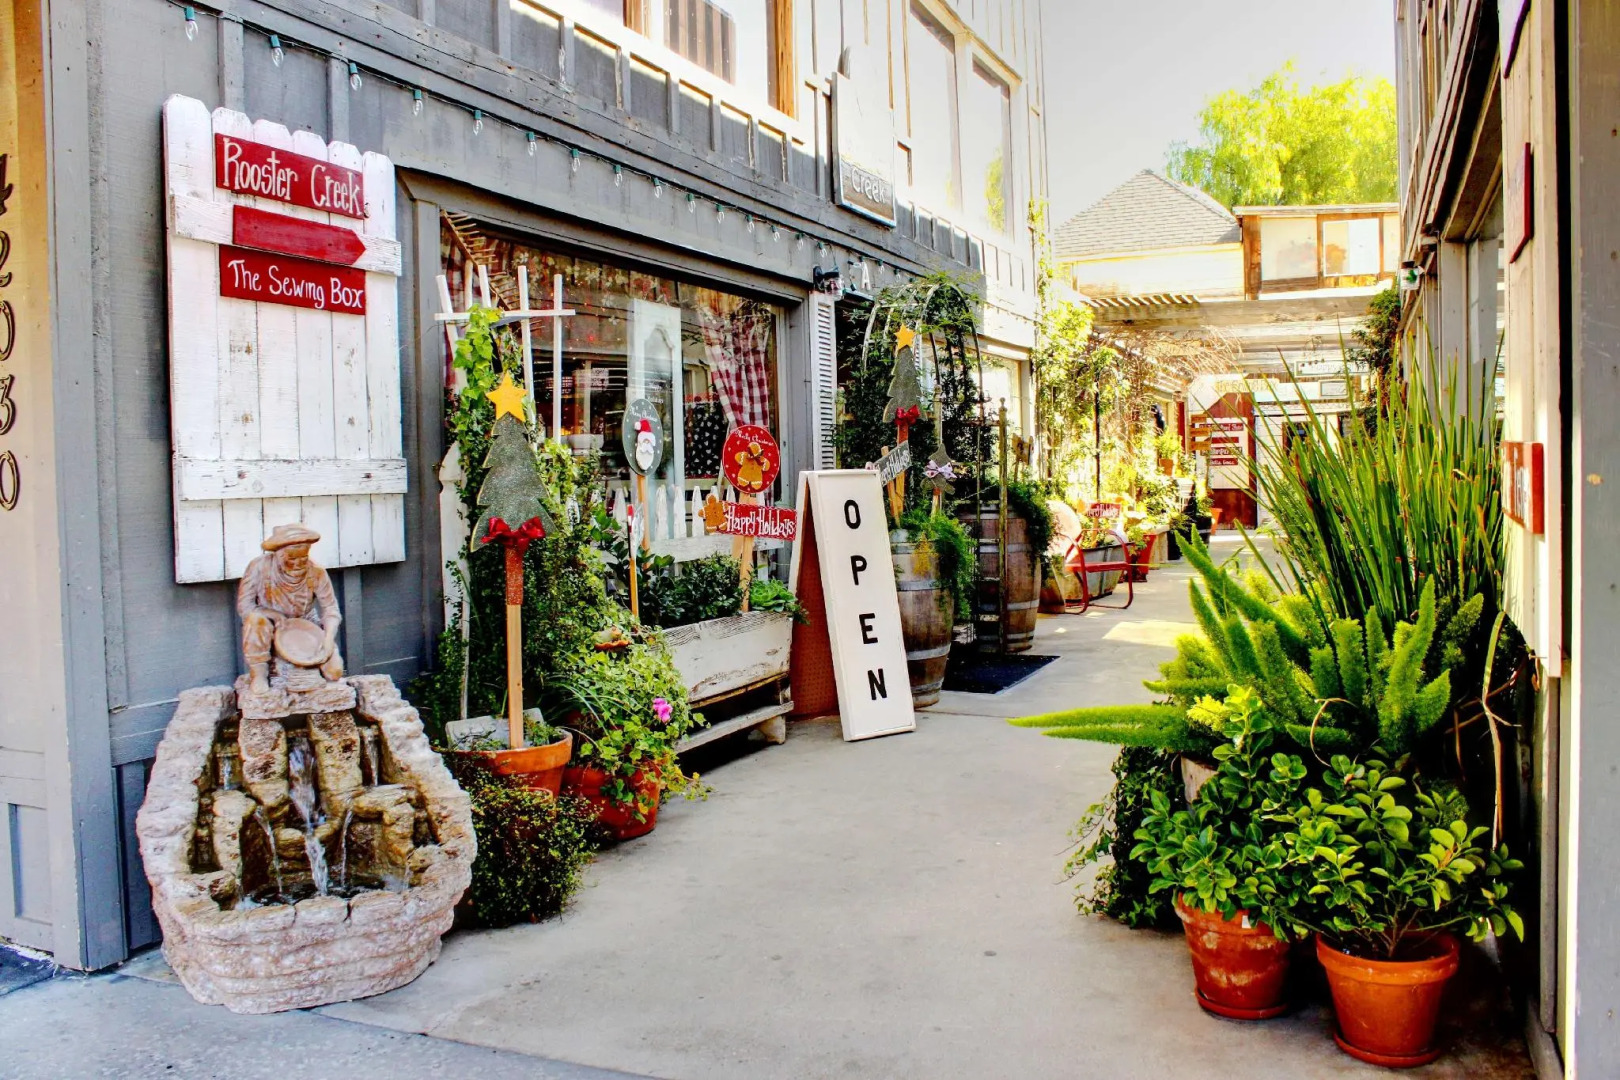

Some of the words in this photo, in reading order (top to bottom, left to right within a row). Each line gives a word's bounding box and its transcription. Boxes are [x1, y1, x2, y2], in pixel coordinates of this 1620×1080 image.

[222, 137, 298, 200] Rooster
[310, 164, 363, 217] Creek
[851, 167, 885, 204] Creek
[227, 259, 261, 291] The
[268, 264, 325, 309] Sewing
[330, 277, 364, 309] Box
[726, 505, 756, 535] Happy
[756, 508, 795, 538] Holidays
[843, 499, 888, 701] OPEN
